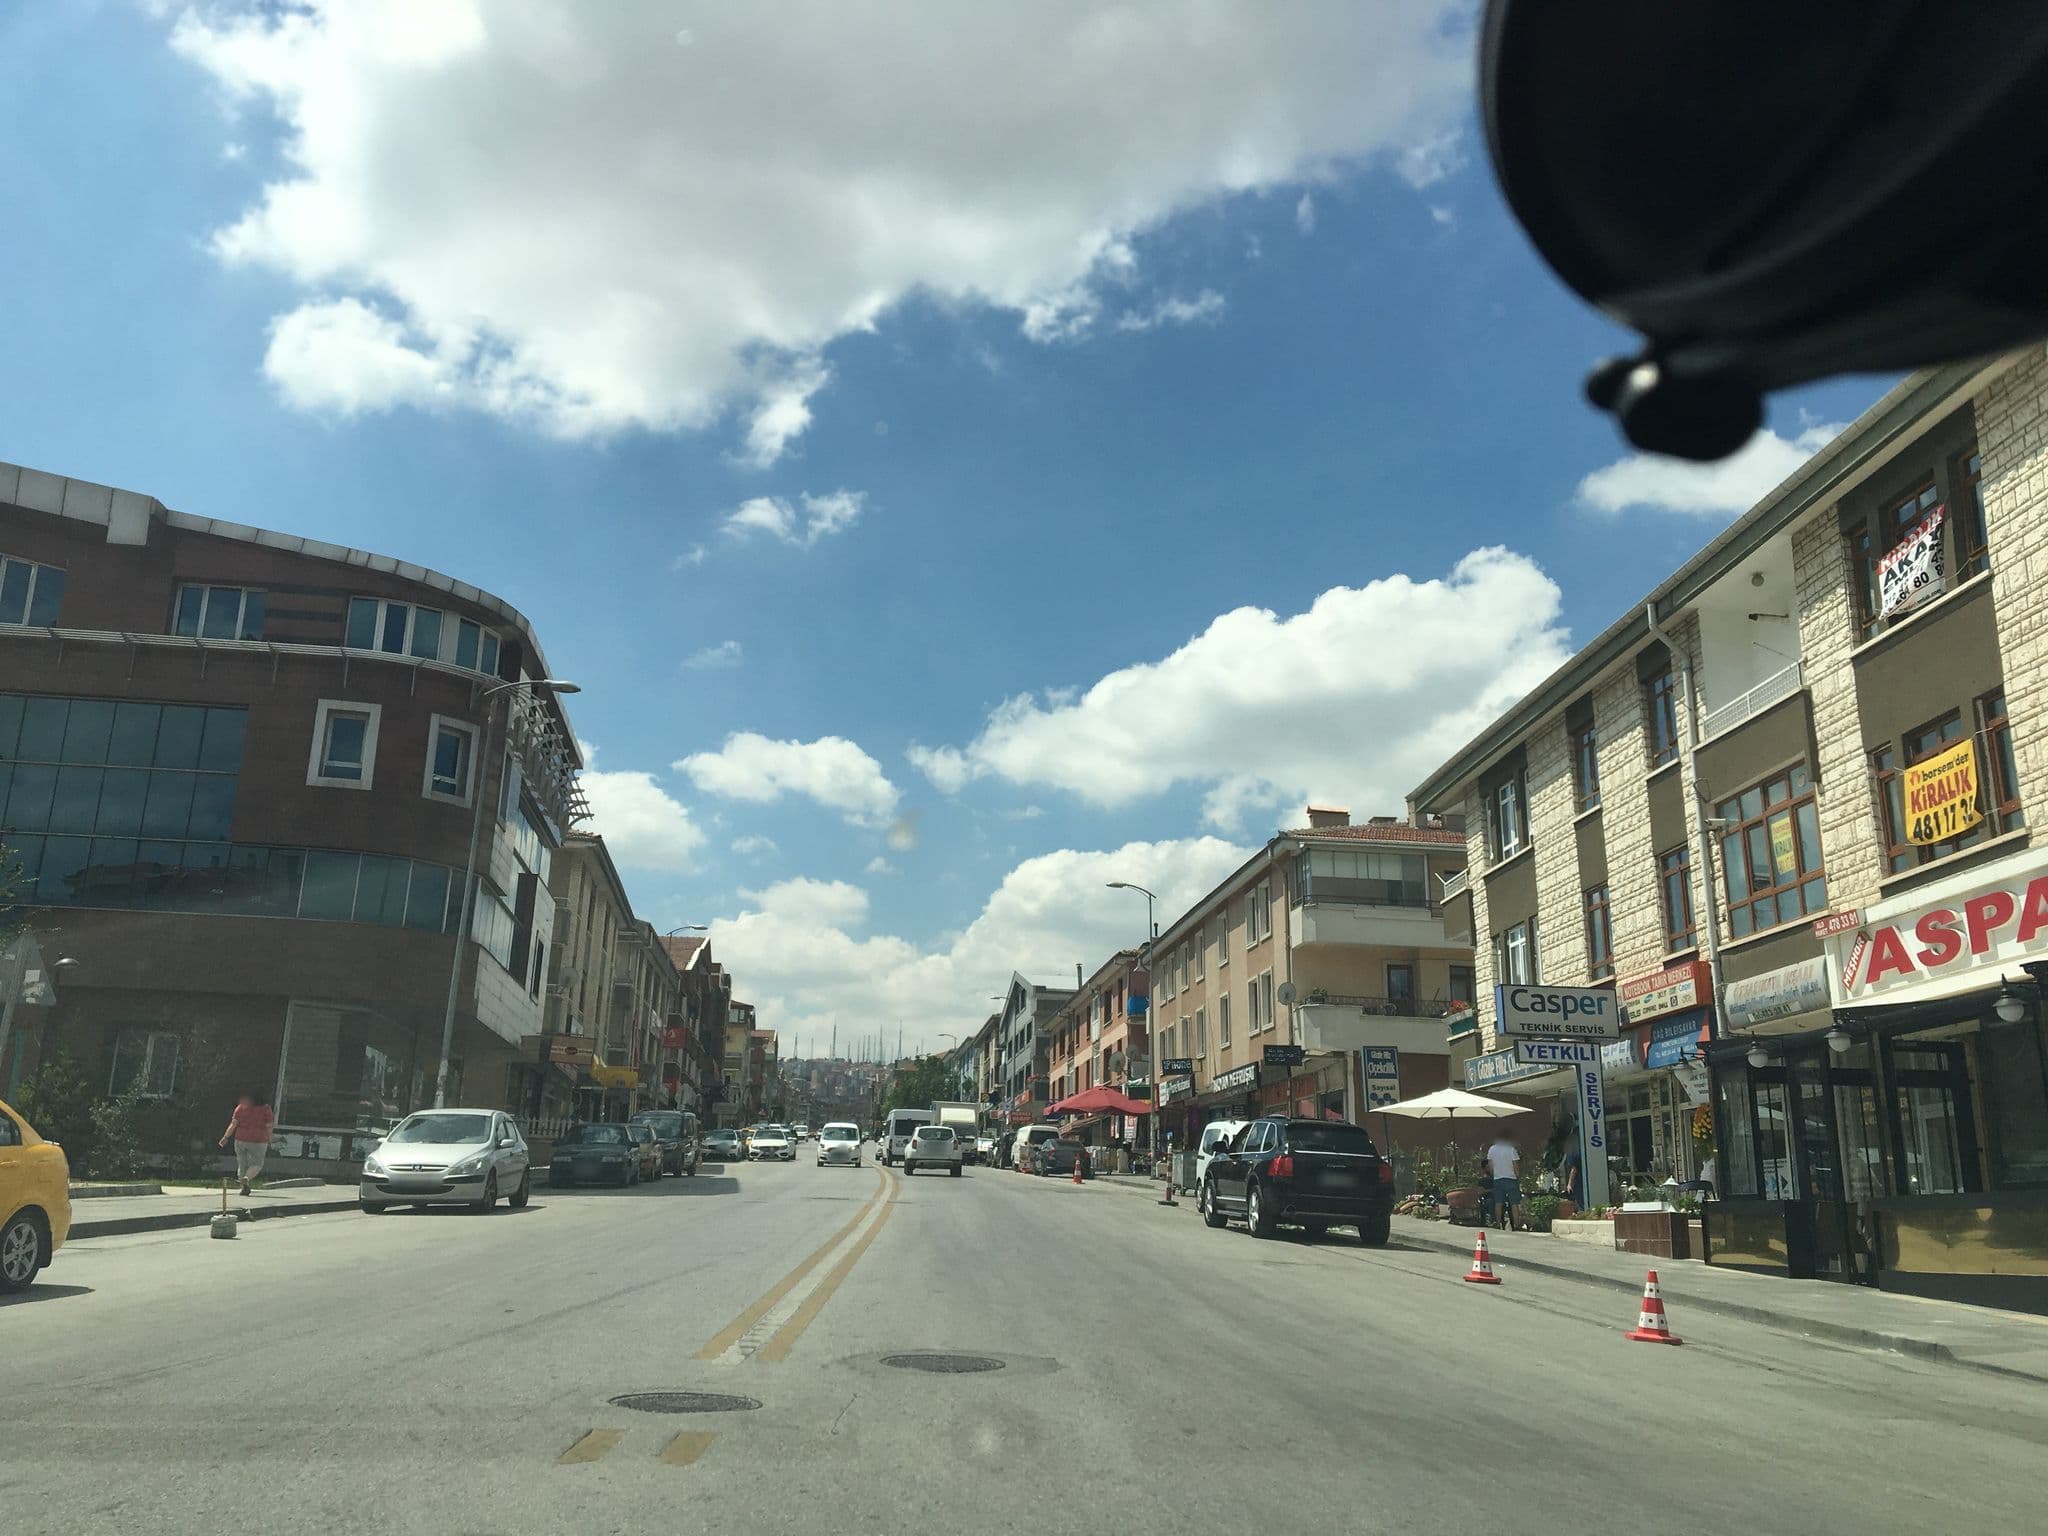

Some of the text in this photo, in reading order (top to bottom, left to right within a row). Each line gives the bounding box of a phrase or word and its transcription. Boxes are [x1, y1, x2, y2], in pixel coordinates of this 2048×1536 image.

[1510, 988, 1608, 1021] Casper
[1520, 1022, 1605, 1035] TEKNİK SERVİS
[1525, 1043, 1596, 1061] YETKİLİ
[1586, 1072, 1603, 1148] SERVİS
